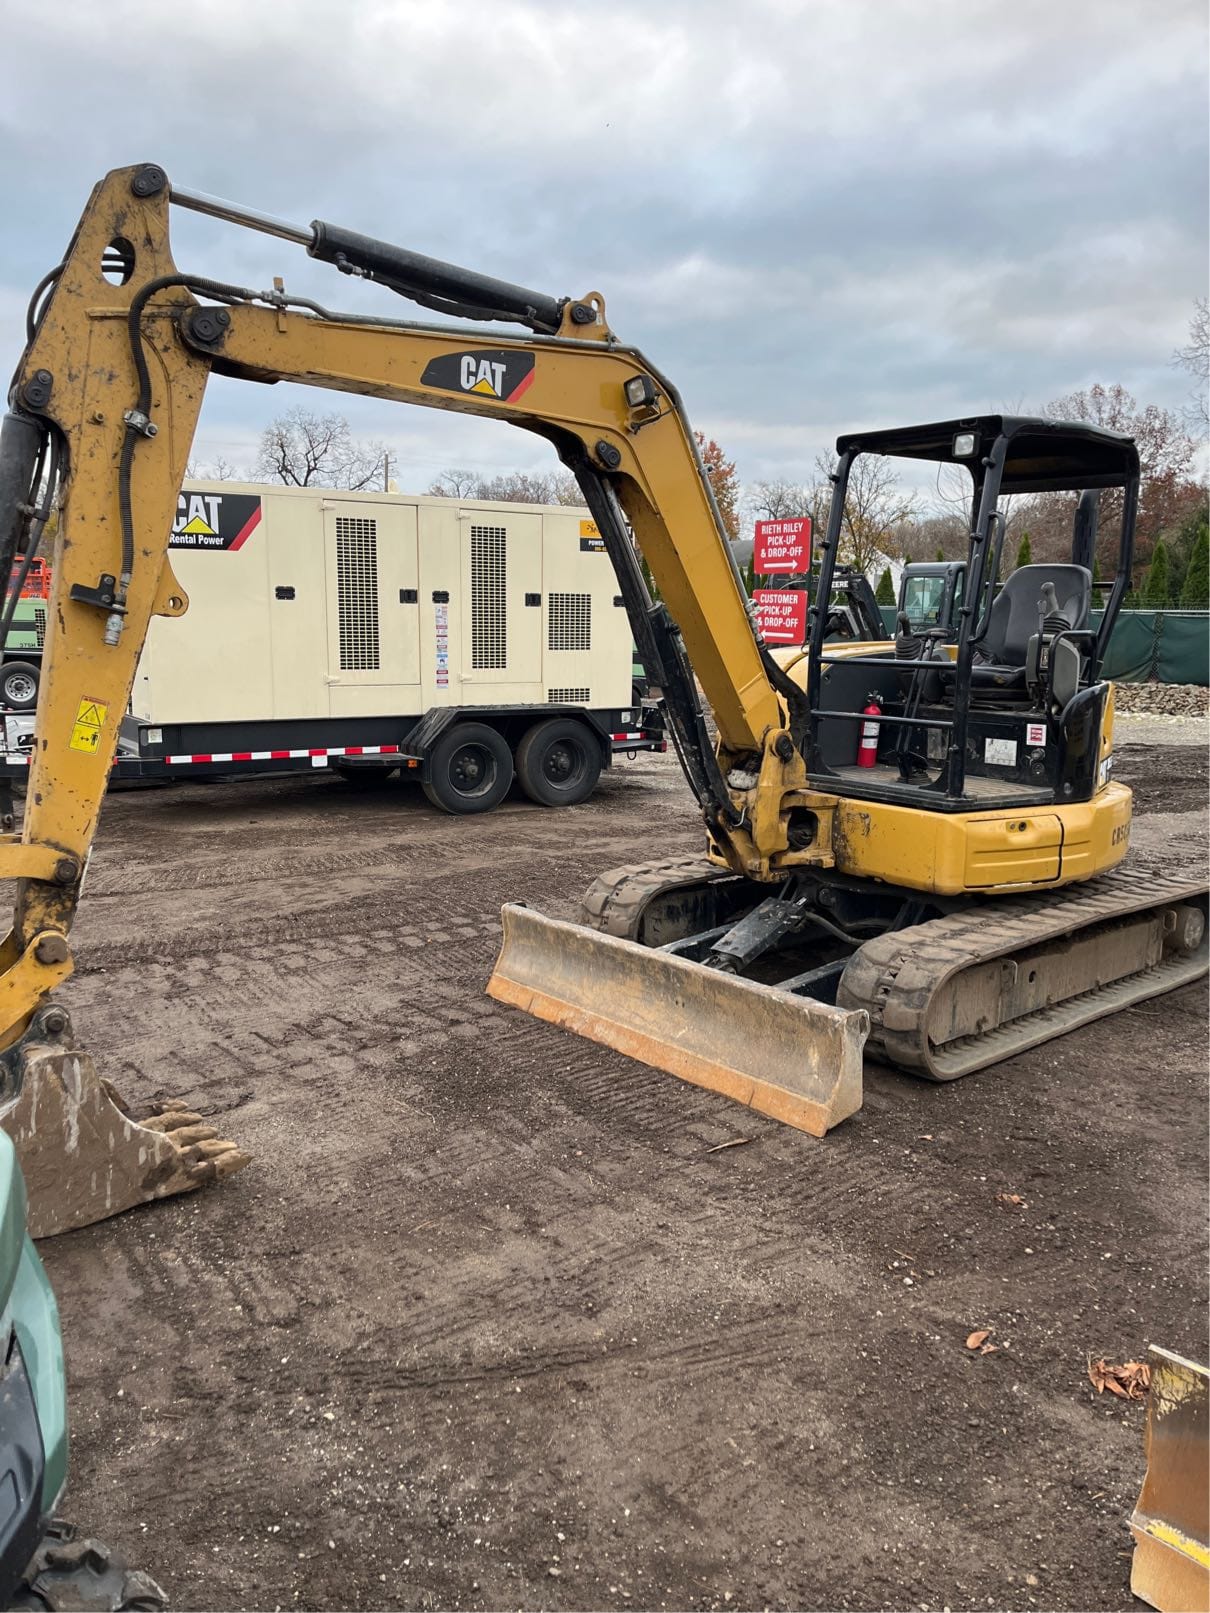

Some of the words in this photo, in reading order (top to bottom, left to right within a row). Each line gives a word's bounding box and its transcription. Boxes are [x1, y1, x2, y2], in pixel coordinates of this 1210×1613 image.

[460, 355, 507, 397] CAT
[172, 494, 222, 535] CAT
[762, 524, 782, 534] RIETH
[783, 522, 803, 533] RILEY
[170, 533, 196, 545] Rental
[198, 534, 224, 546] Power
[767, 534, 797, 546] PICK-UP
[760, 549, 766, 558] &
[768, 546, 803, 558] DROP-OFF
[760, 593, 798, 604] CUSTOMER
[764, 605, 793, 616] PICK-UP
[764, 617, 799, 628] DROP-OFF
